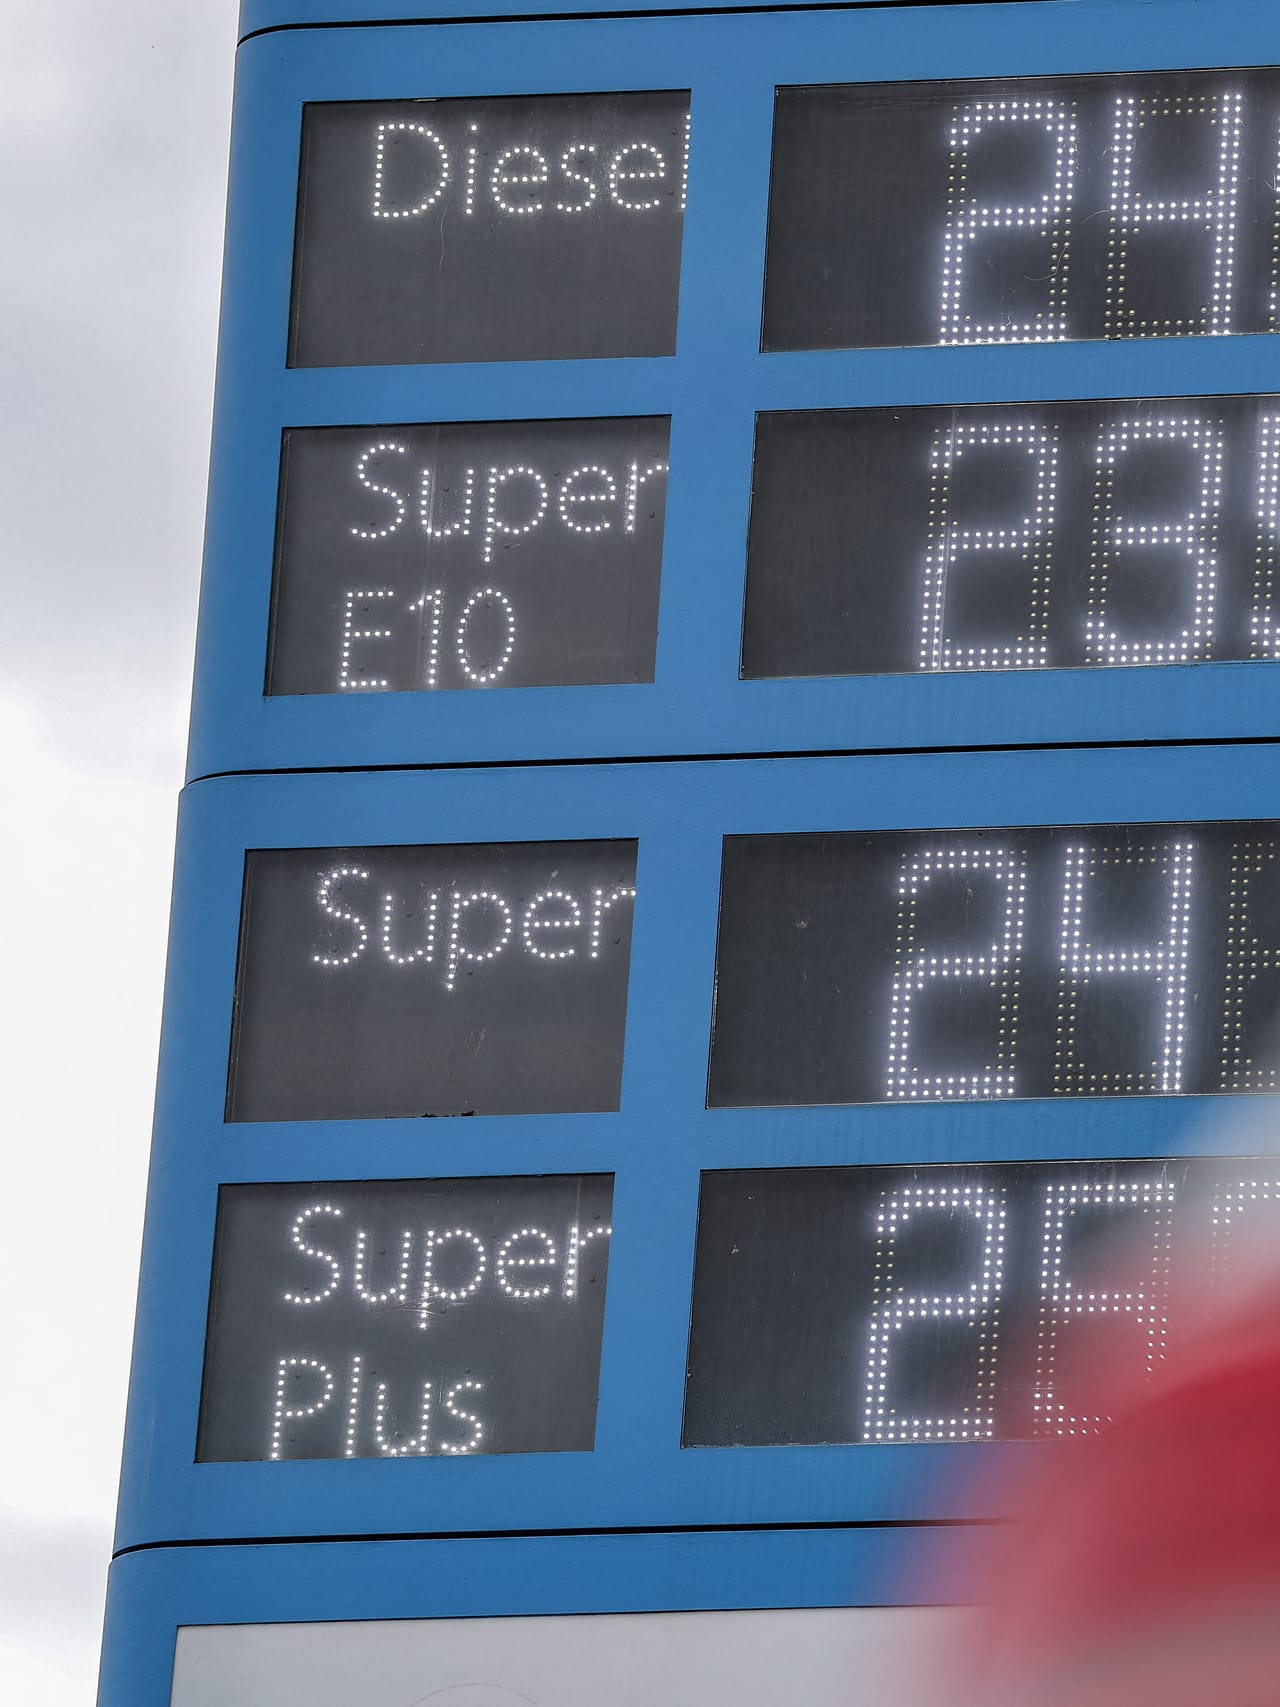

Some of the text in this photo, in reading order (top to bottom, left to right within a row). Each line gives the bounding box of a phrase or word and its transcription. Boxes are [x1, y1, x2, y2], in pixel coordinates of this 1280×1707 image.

[372, 113, 692, 219] Diesel
[350, 442, 671, 562] Super
[339, 588, 516, 688] E10
[313, 868, 638, 990] Super
[283, 1205, 613, 1329] Super
[271, 1355, 485, 1460] Plus
